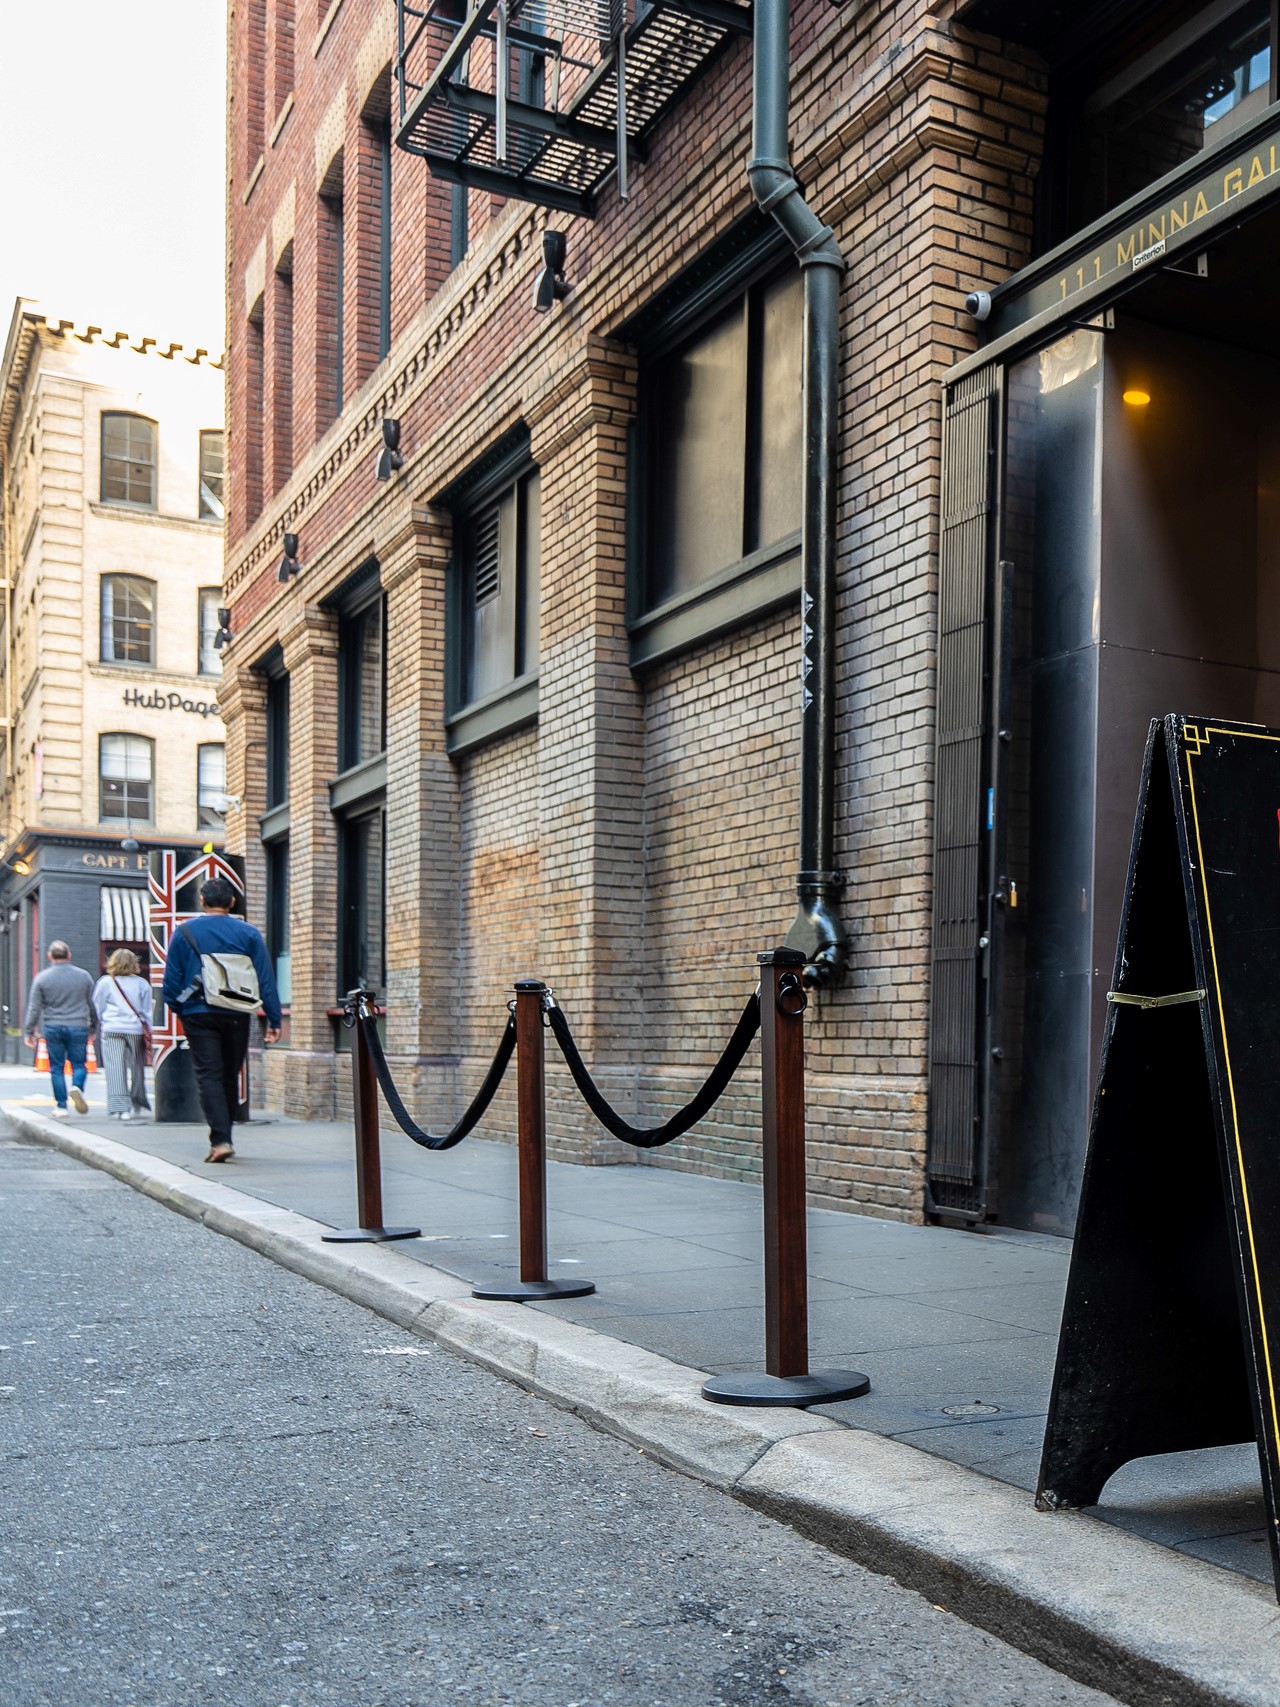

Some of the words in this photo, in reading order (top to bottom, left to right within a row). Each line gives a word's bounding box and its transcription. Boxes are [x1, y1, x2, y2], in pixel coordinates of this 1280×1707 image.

[1059, 255, 1100, 300] 111
[1117, 191, 1208, 266] MINNA
[1133, 243, 1165, 268] Criterion
